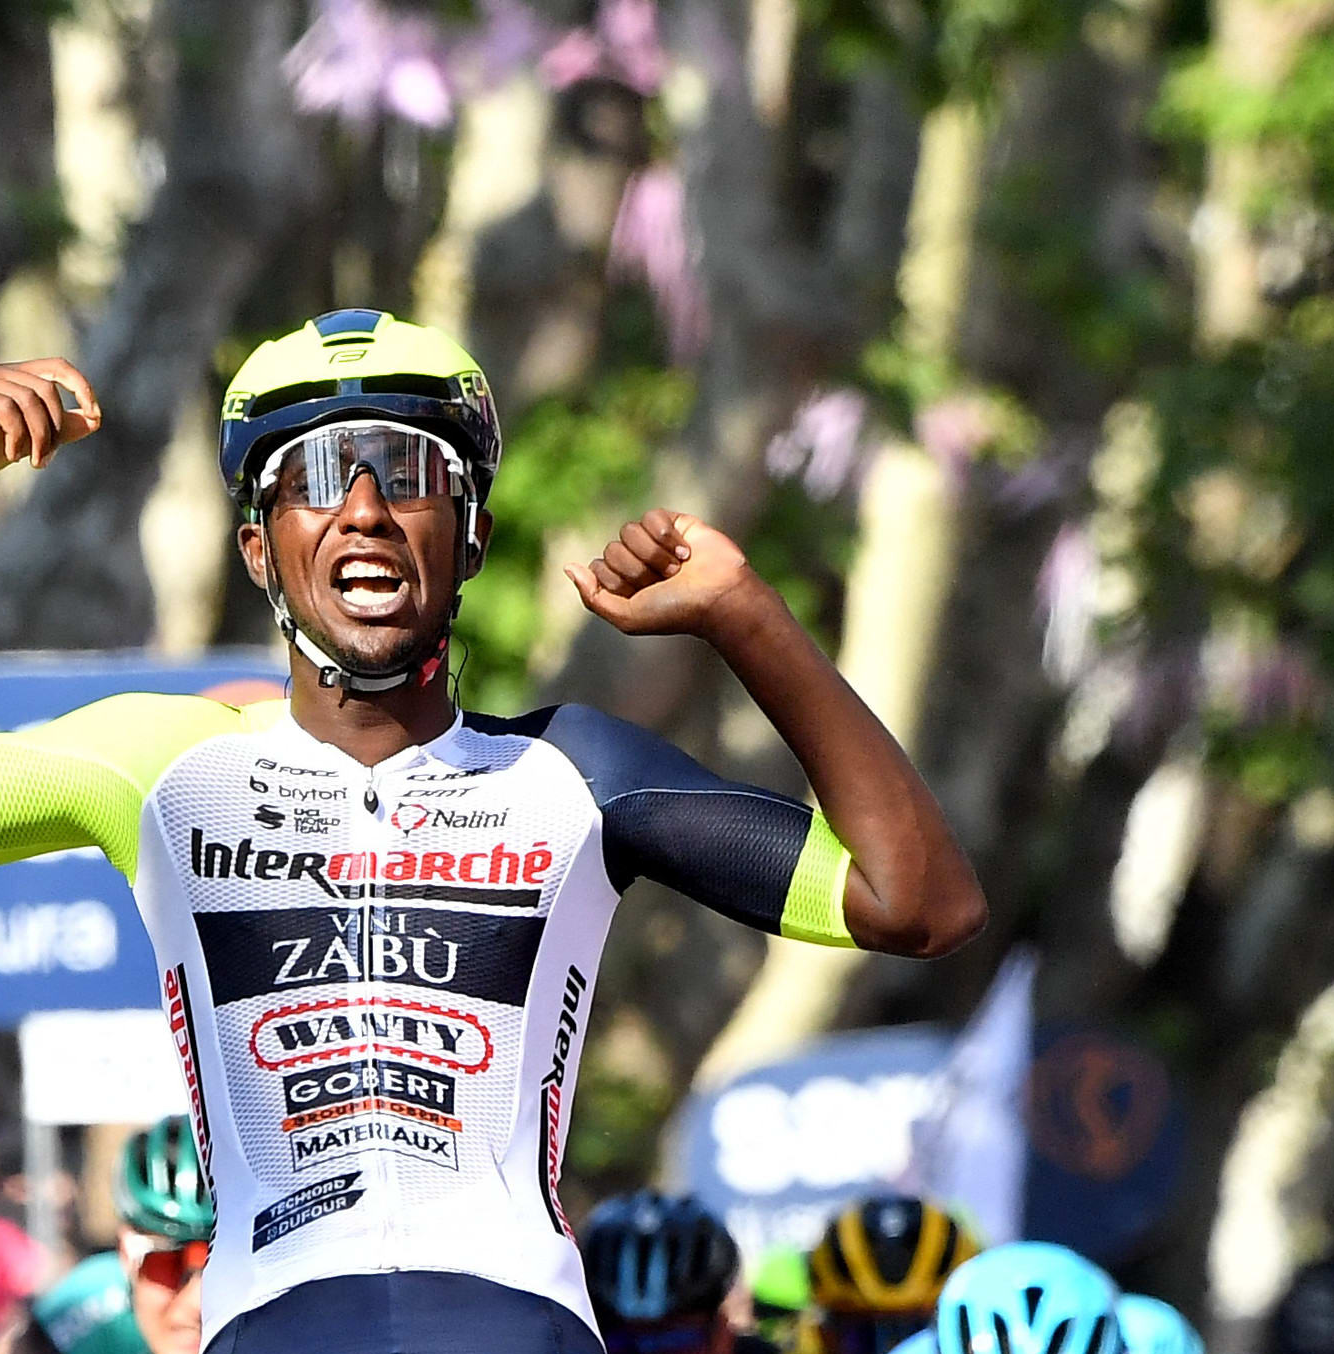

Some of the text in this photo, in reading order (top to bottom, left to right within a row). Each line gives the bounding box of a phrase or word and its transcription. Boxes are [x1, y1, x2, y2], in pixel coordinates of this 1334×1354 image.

[278, 783, 348, 801] bryton
[293, 817, 342, 827] WORLD
[431, 808, 511, 829] Nalini
[190, 827, 553, 890] Intermarché
[331, 913, 408, 936] VINI
[271, 928, 463, 985] ZABÙ
[272, 1012, 466, 1055] WANTY
[288, 1067, 451, 1105] GOBERT
[295, 1122, 452, 1162] MATERIAUX
[276, 1196, 348, 1235] DUFOUR
